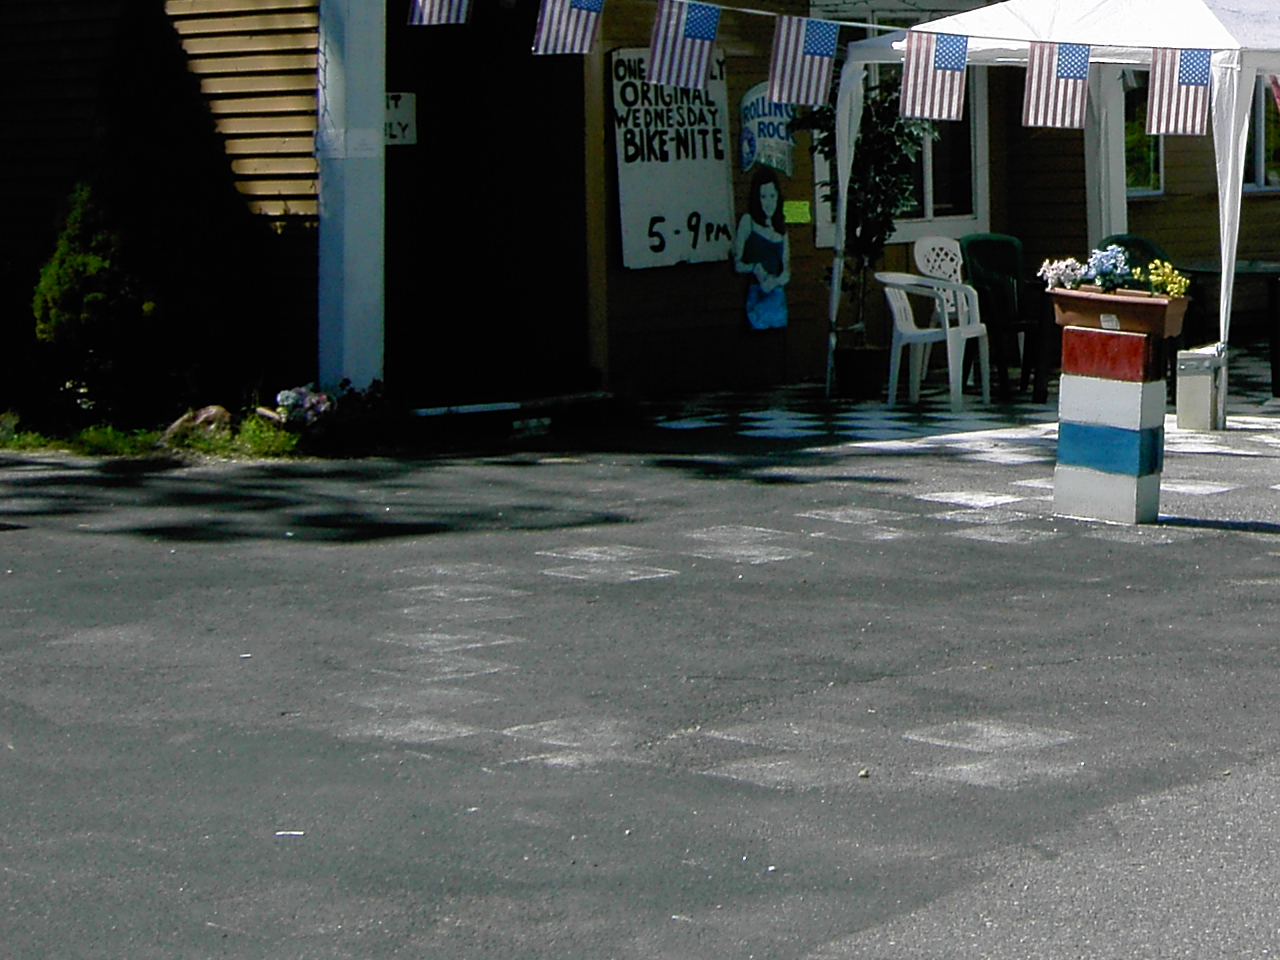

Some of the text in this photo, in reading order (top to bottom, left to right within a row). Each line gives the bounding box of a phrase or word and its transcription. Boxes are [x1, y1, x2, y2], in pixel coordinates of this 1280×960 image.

[614, 58, 646, 81] ONE
[620, 81, 715, 107] ORIGINAL
[614, 106, 719, 129] WEDNESDAY
[623, 128, 725, 163] BIKE-NITE
